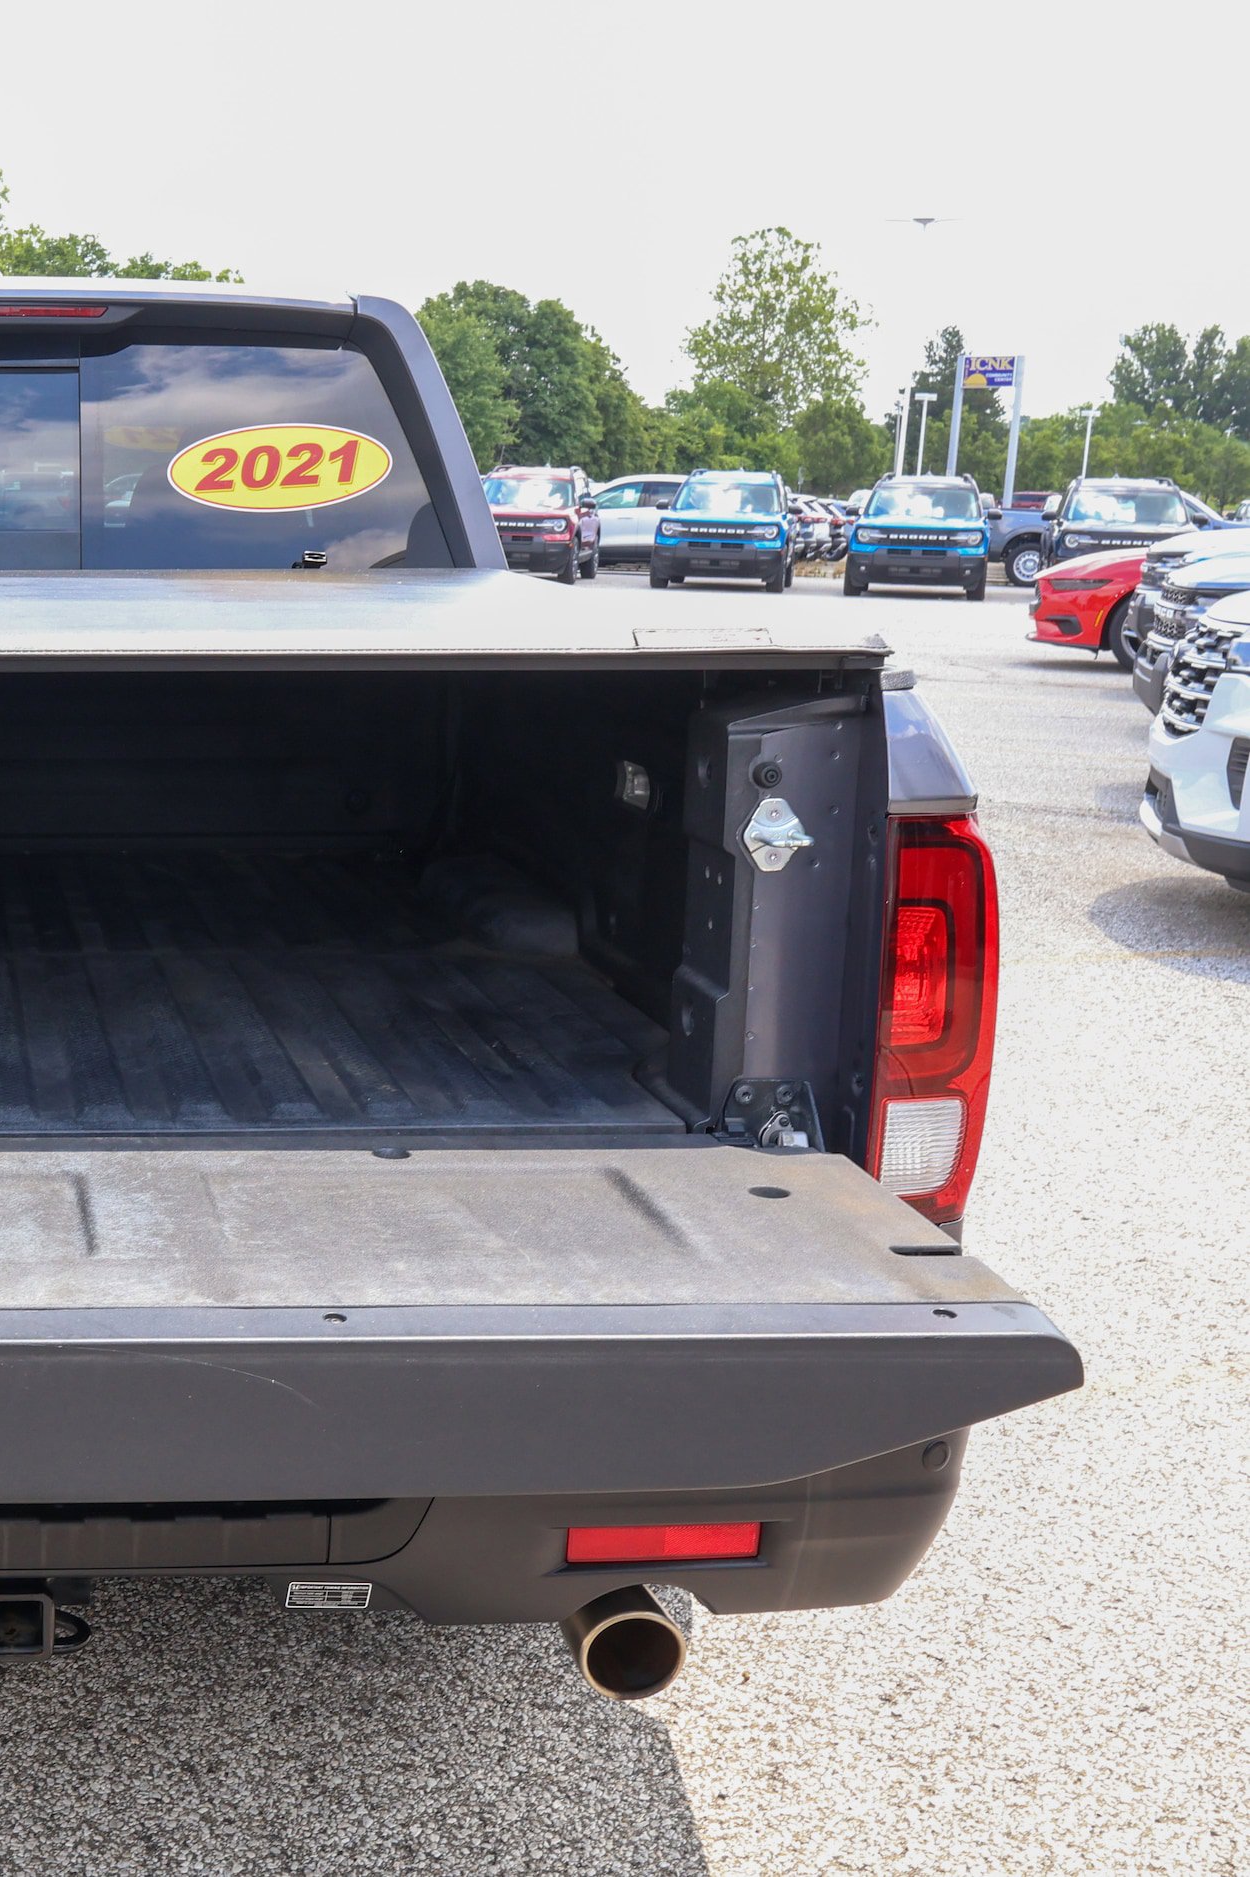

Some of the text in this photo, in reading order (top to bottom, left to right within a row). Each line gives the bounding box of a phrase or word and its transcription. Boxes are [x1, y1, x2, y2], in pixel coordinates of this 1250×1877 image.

[969, 357, 1014, 371] ICNK
[193, 440, 360, 493] 2021
[889, 533, 947, 541] BRONCO
